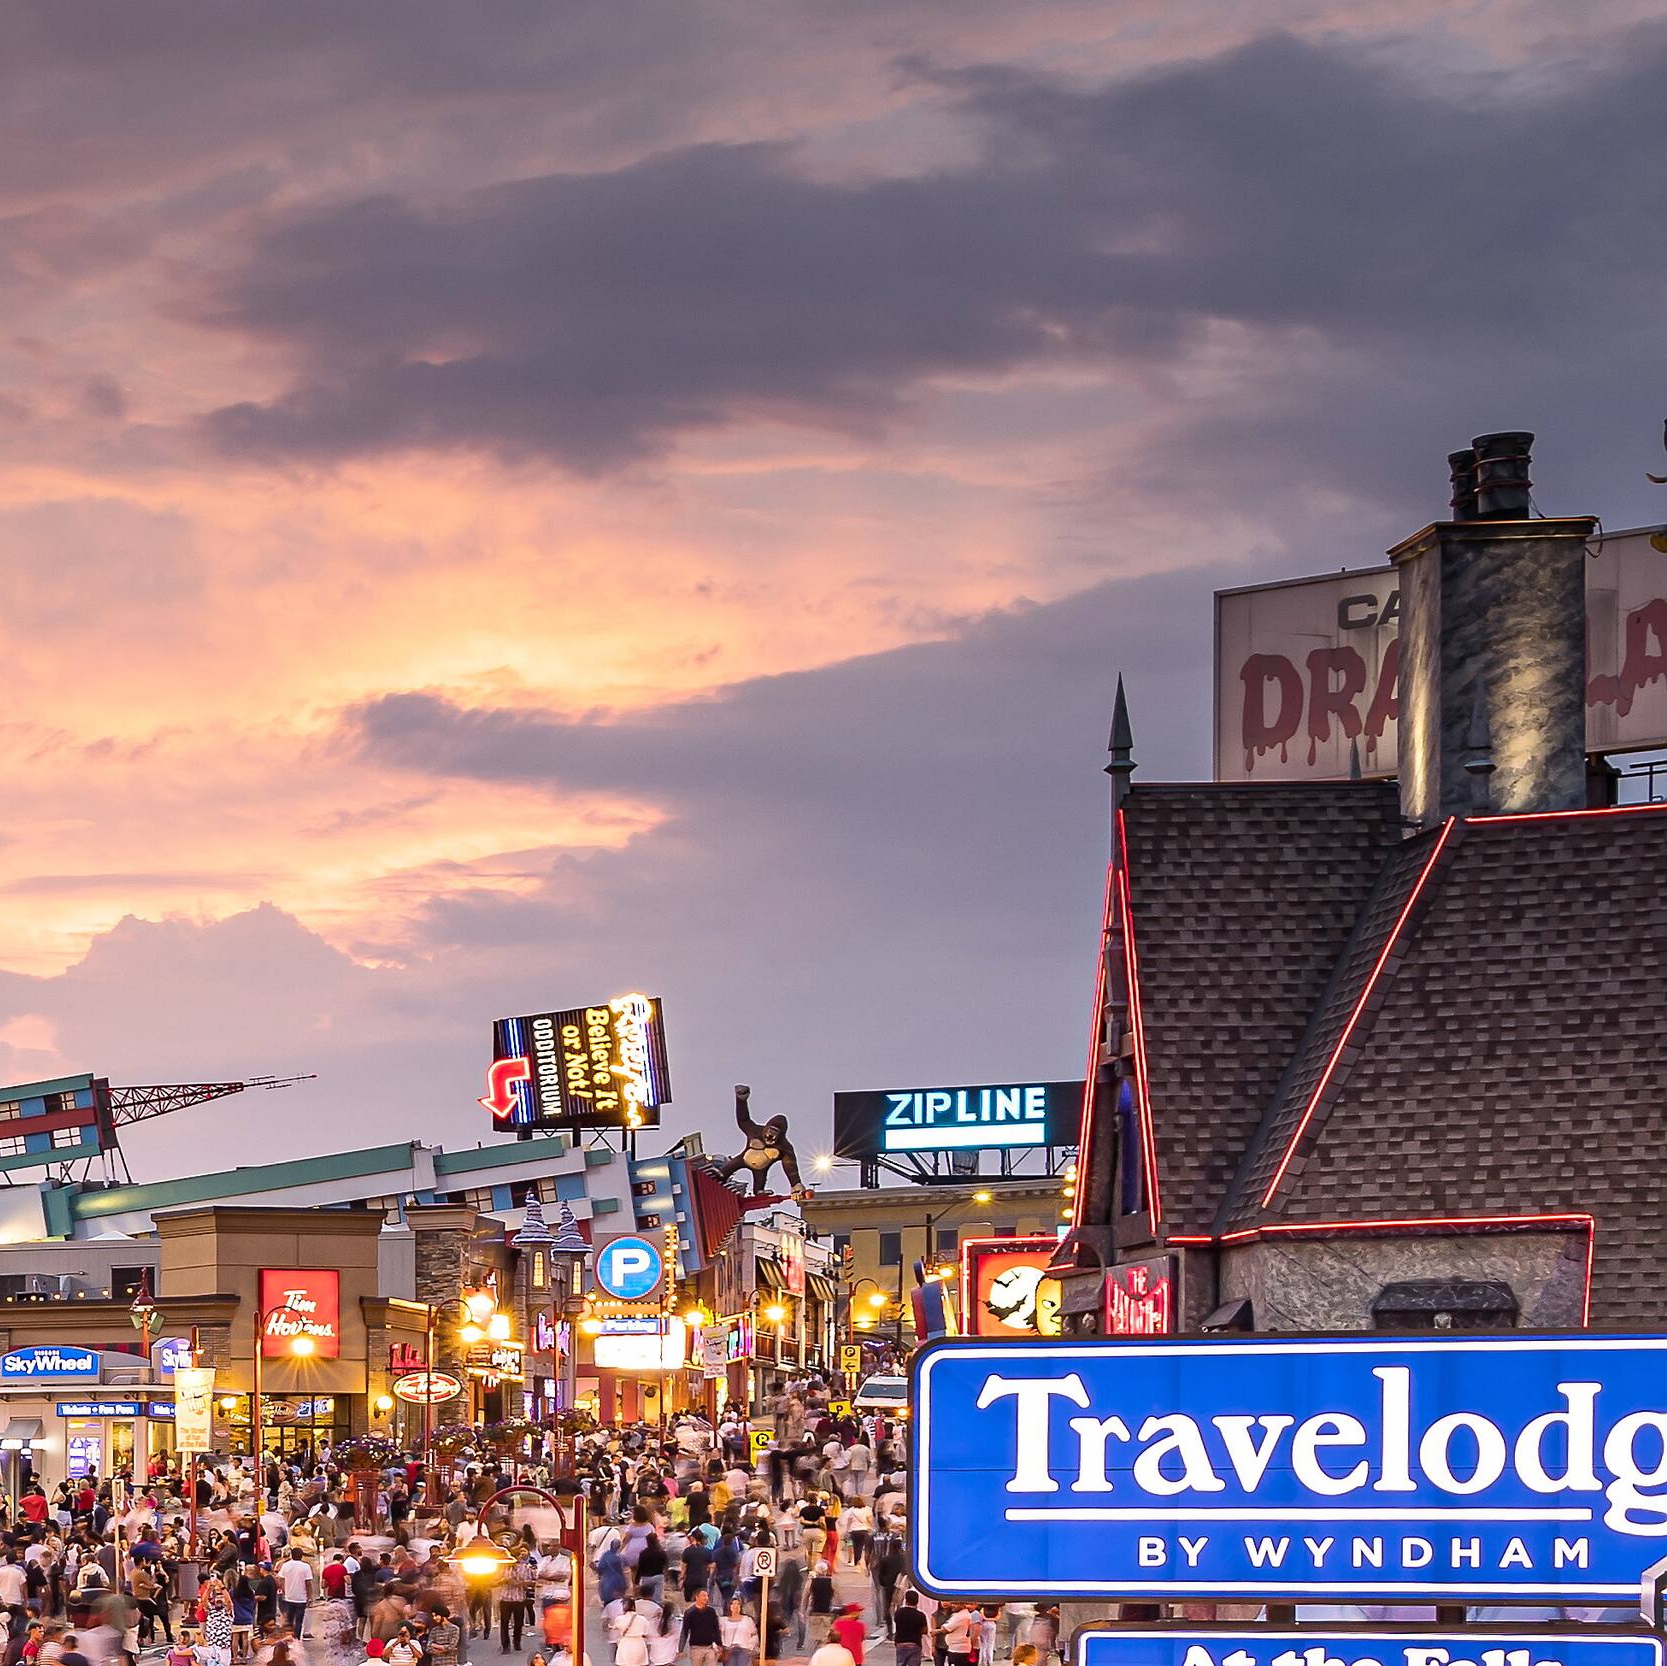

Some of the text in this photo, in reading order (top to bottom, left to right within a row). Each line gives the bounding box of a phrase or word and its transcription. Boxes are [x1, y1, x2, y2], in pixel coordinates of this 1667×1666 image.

[533, 1018, 562, 1116] ODDITORIUM
[562, 1025, 593, 1098] or Not!
[586, 1007, 618, 1110] Believe It
[611, 1248, 651, 1287] P
[284, 1290, 317, 1313] Tim
[4, 1355, 92, 1374] SkyWheel
[976, 1366, 1667, 1538] Travelodg
[1137, 1536, 1590, 1570] BY WYNDHAM
